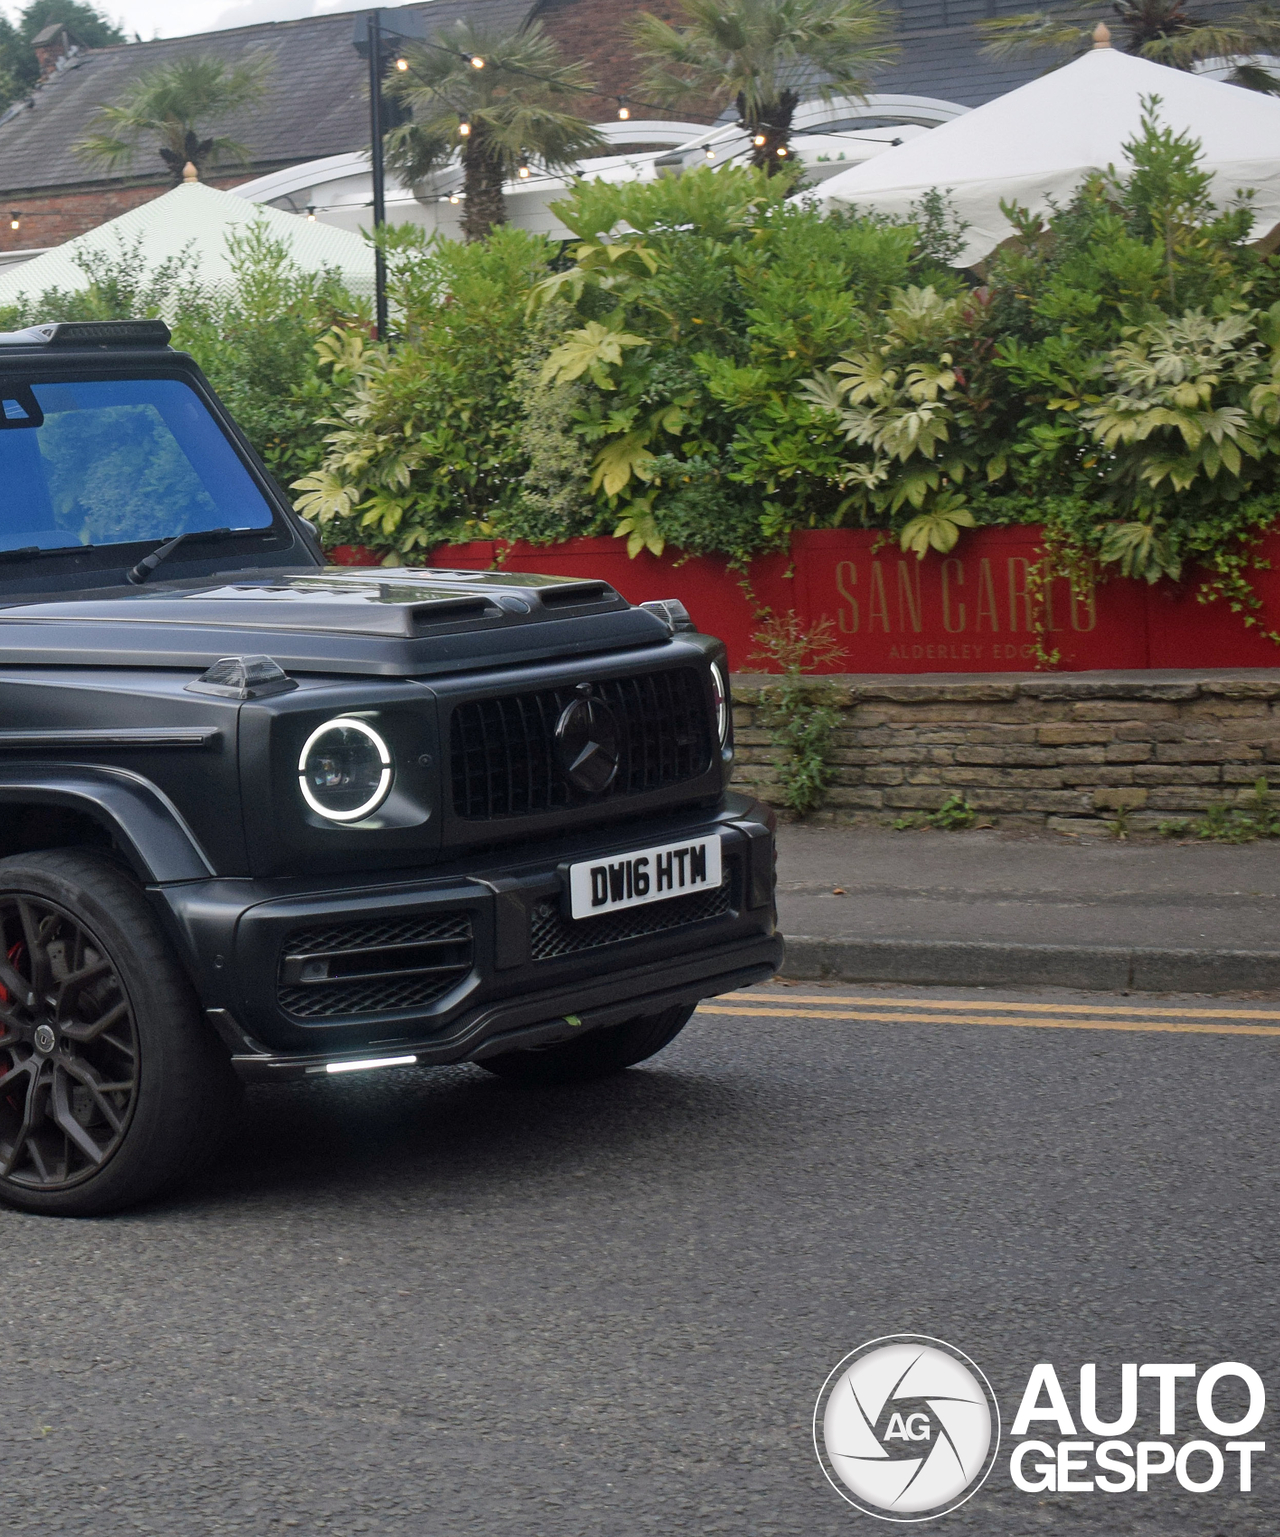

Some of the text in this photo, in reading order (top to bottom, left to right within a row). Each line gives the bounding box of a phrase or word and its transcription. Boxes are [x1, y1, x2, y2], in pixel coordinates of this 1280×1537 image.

[835, 560, 923, 634] SAN
[889, 644, 1044, 660] ALDERLEY EDG
[589, 843, 707, 907] DW16 HTM
